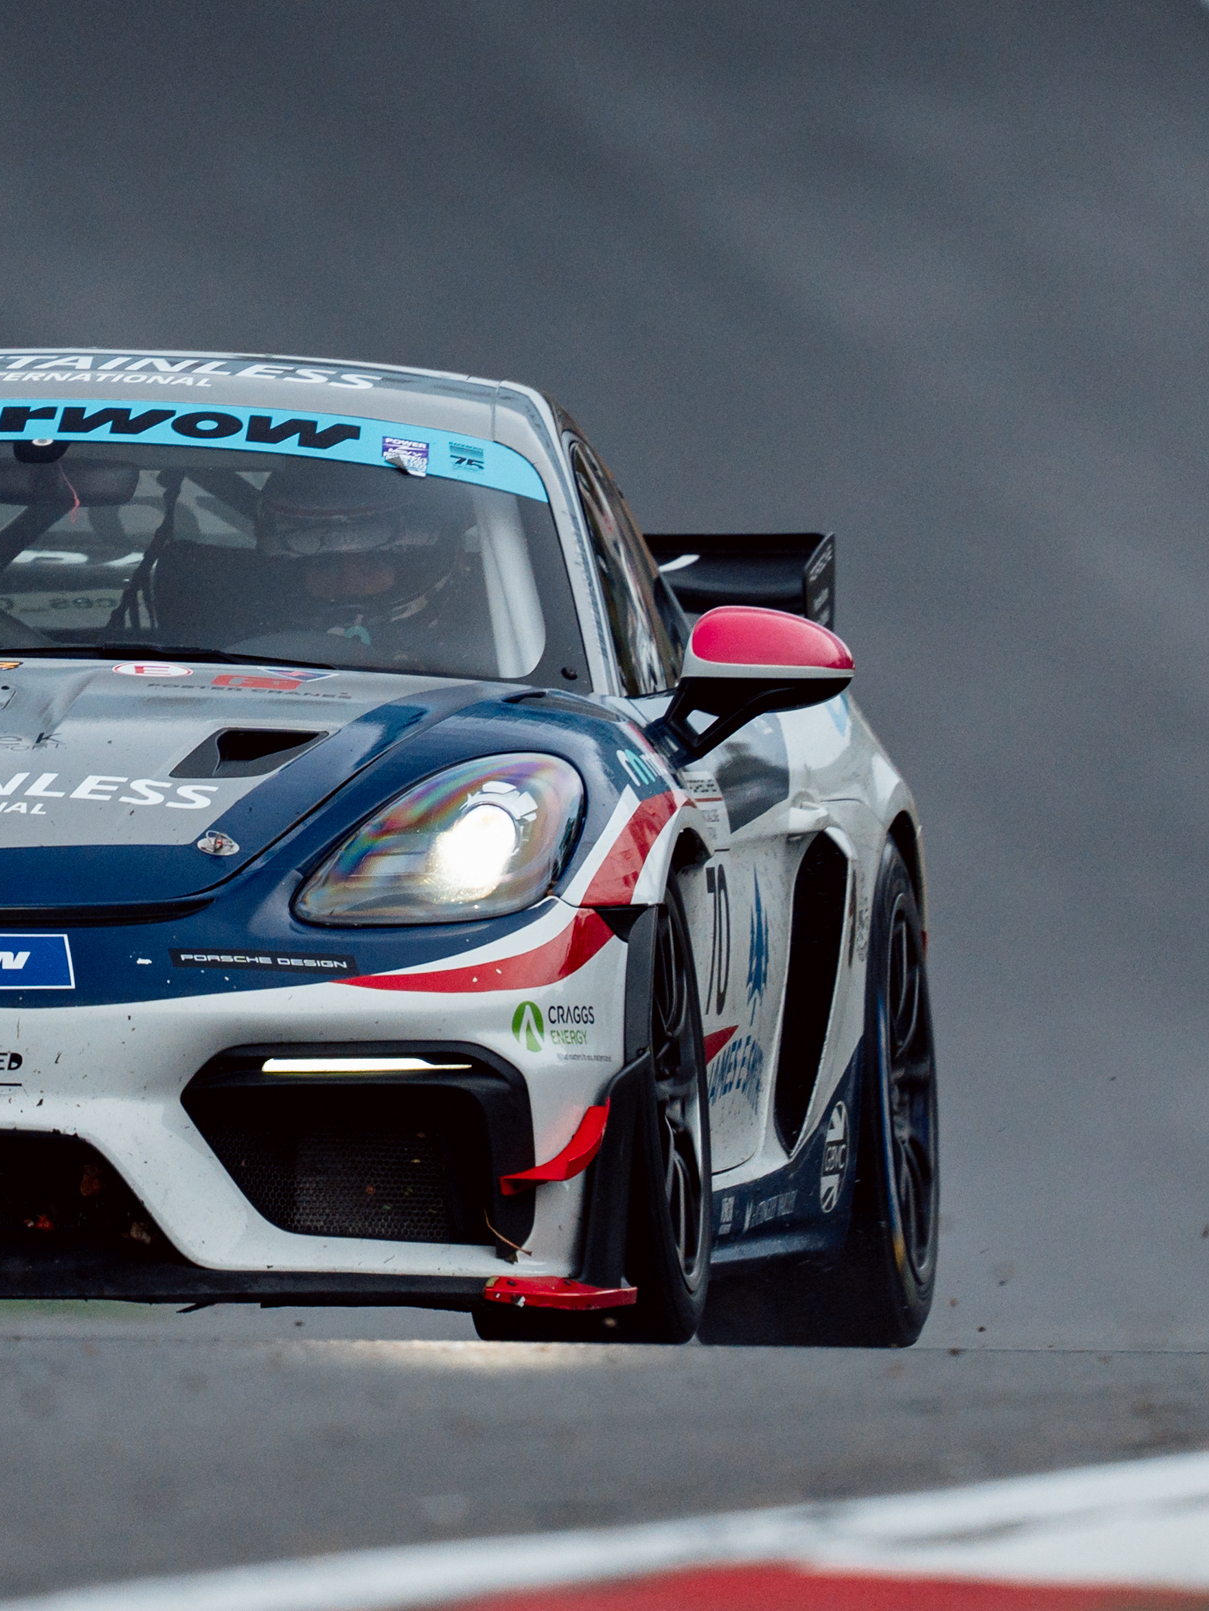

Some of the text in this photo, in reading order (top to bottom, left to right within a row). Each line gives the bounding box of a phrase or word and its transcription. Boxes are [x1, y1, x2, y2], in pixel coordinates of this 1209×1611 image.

[385, 437, 427, 449] POWER
[147, 683, 352, 700] FOSTER CRANES
[705, 864, 731, 1016] 70
[180, 953, 348, 969] PORSCHE DESIGN
[548, 1005, 595, 1025] CRAGGS
[550, 1029, 588, 1045] ENERGY
